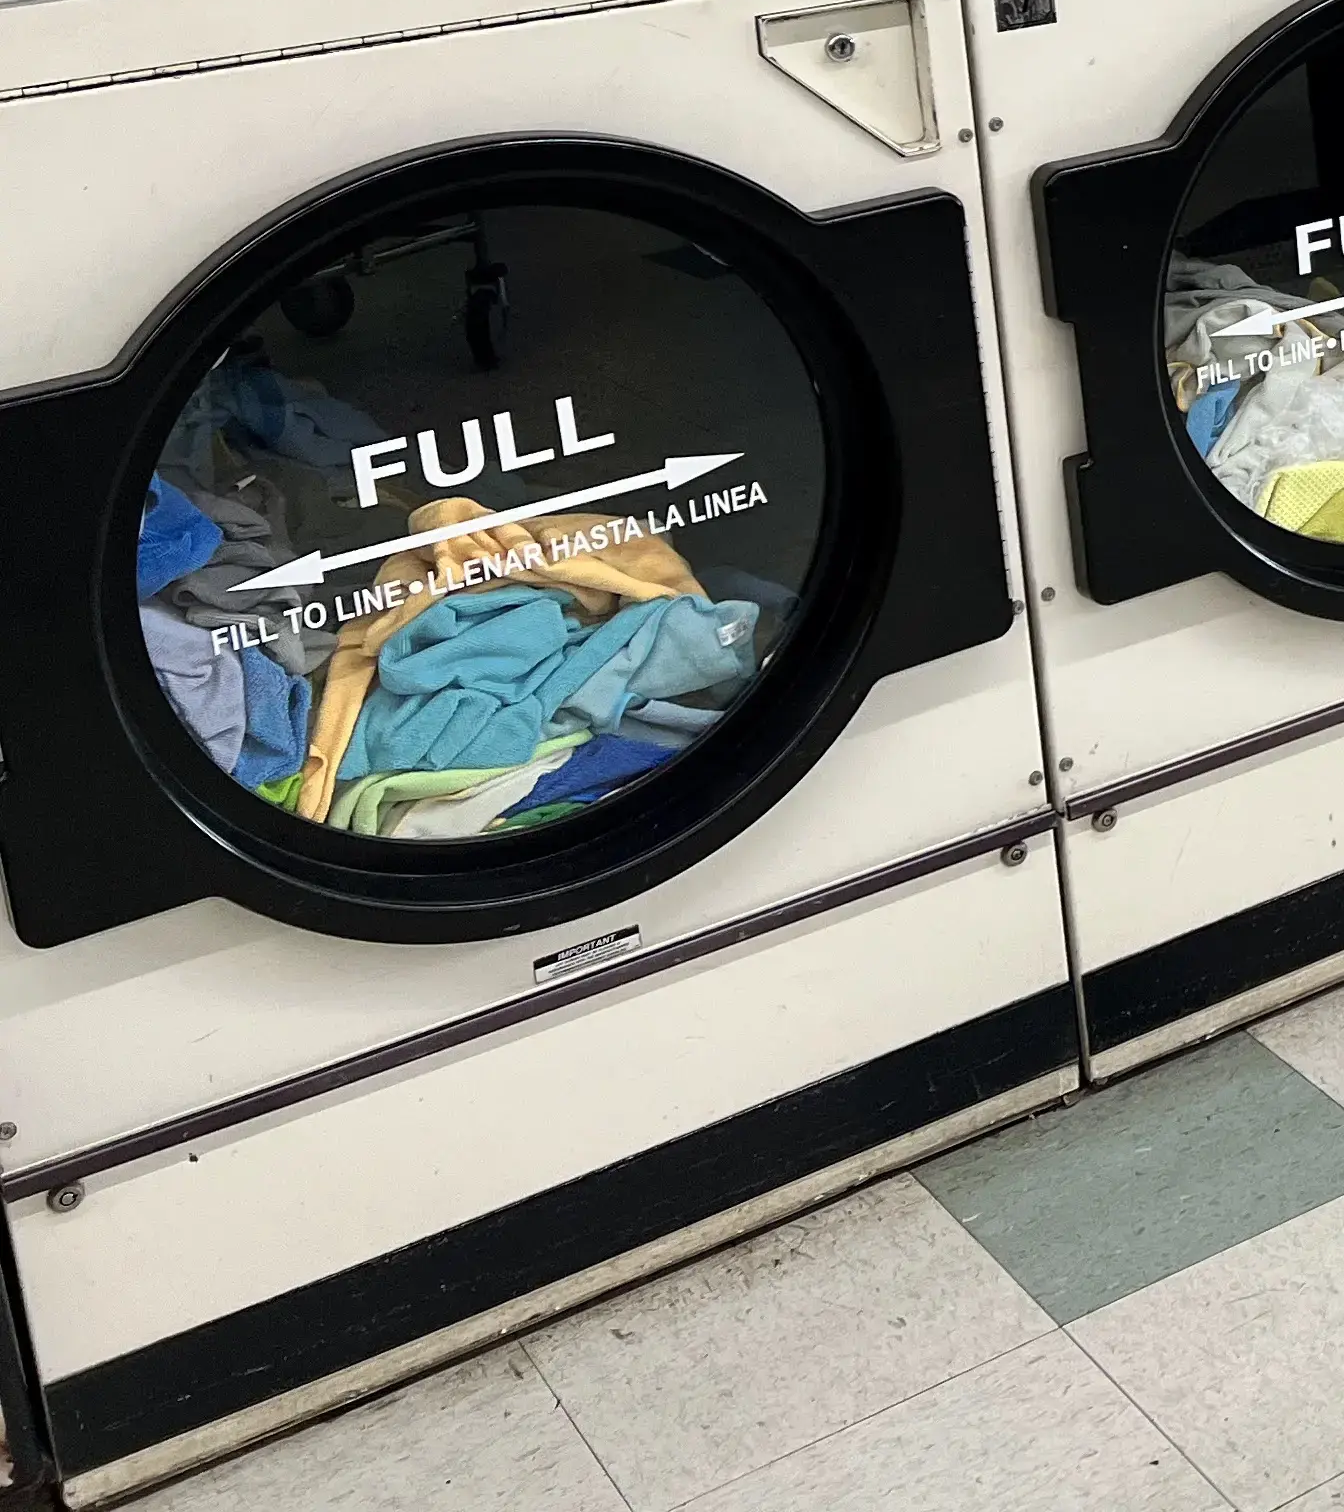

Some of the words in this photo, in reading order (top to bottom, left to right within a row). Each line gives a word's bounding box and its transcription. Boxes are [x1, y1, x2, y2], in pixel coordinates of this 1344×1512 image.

[1197, 358, 1241, 388] FILL
[1245, 350, 1273, 373] TO
[1278, 336, 1325, 367] LINE
[350, 396, 615, 509] FULL
[211, 621, 279, 656] FILL
[283, 601, 328, 635] TO
[336, 580, 404, 623] LINE
[426, 544, 543, 597] LLENAR
[550, 519, 644, 563] HASTA
[648, 505, 687, 535] LA
[689, 481, 768, 525] LINEA
